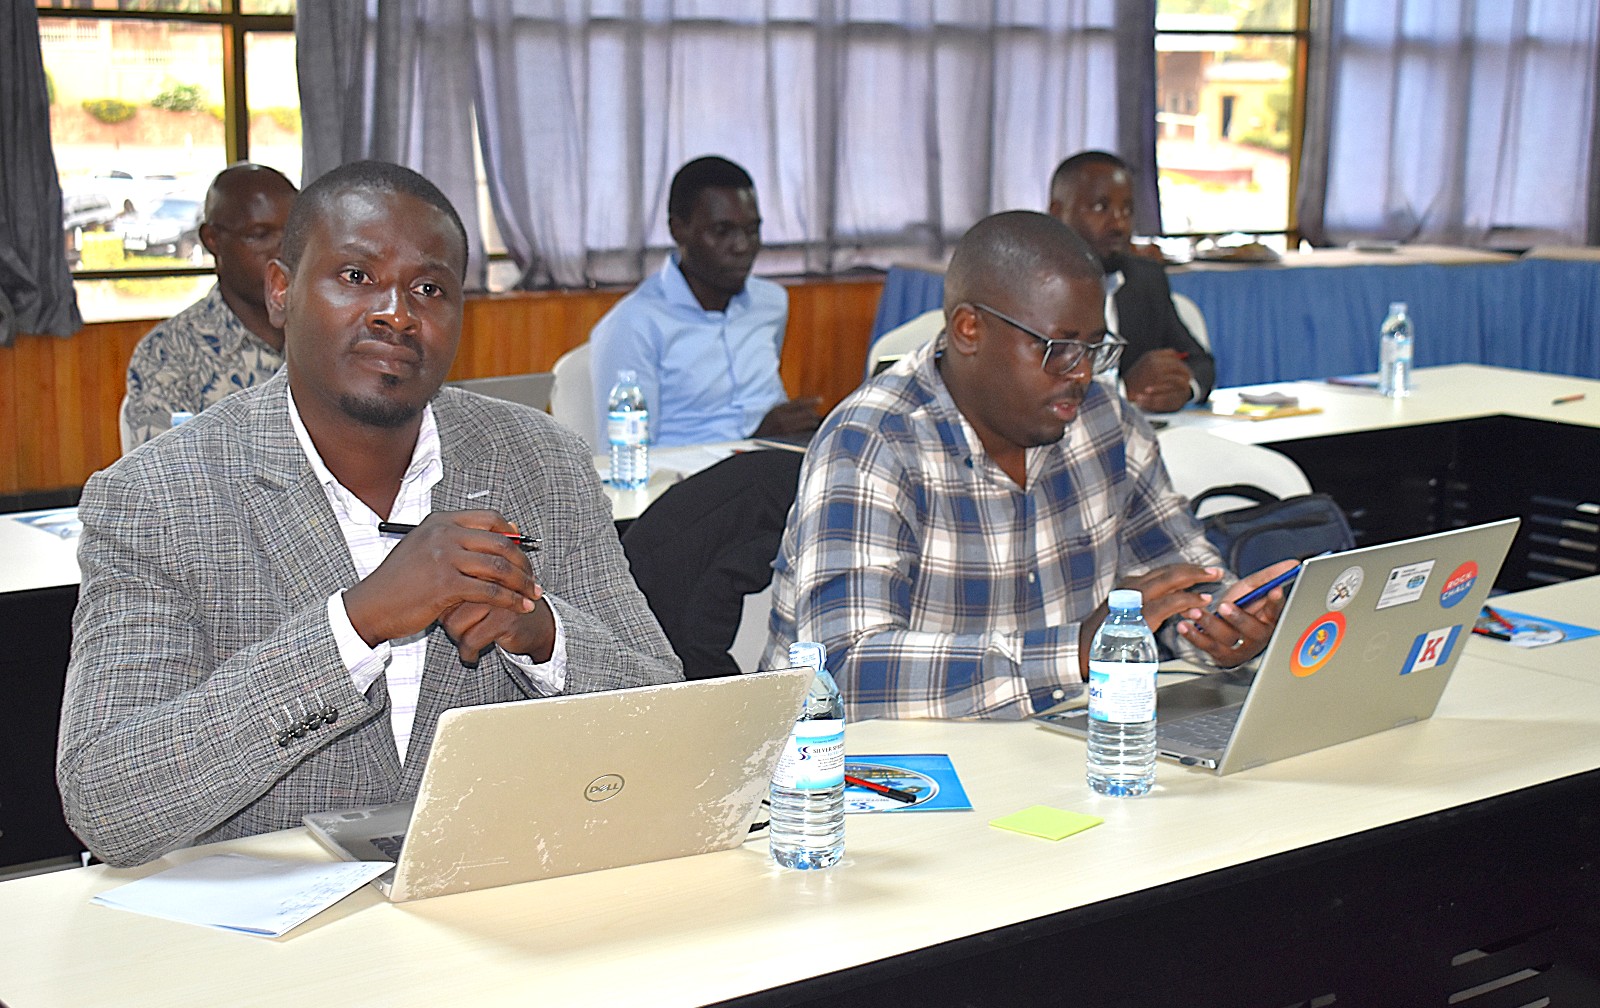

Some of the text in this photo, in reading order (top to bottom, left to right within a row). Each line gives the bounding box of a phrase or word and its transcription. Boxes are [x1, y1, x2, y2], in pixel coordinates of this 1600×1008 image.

[1441, 579, 1473, 601] CHALK
[1446, 570, 1474, 590] ROCK
[1419, 636, 1445, 663] K
[812, 746, 832, 754] SILVER
[589, 783, 619, 793] DELL
